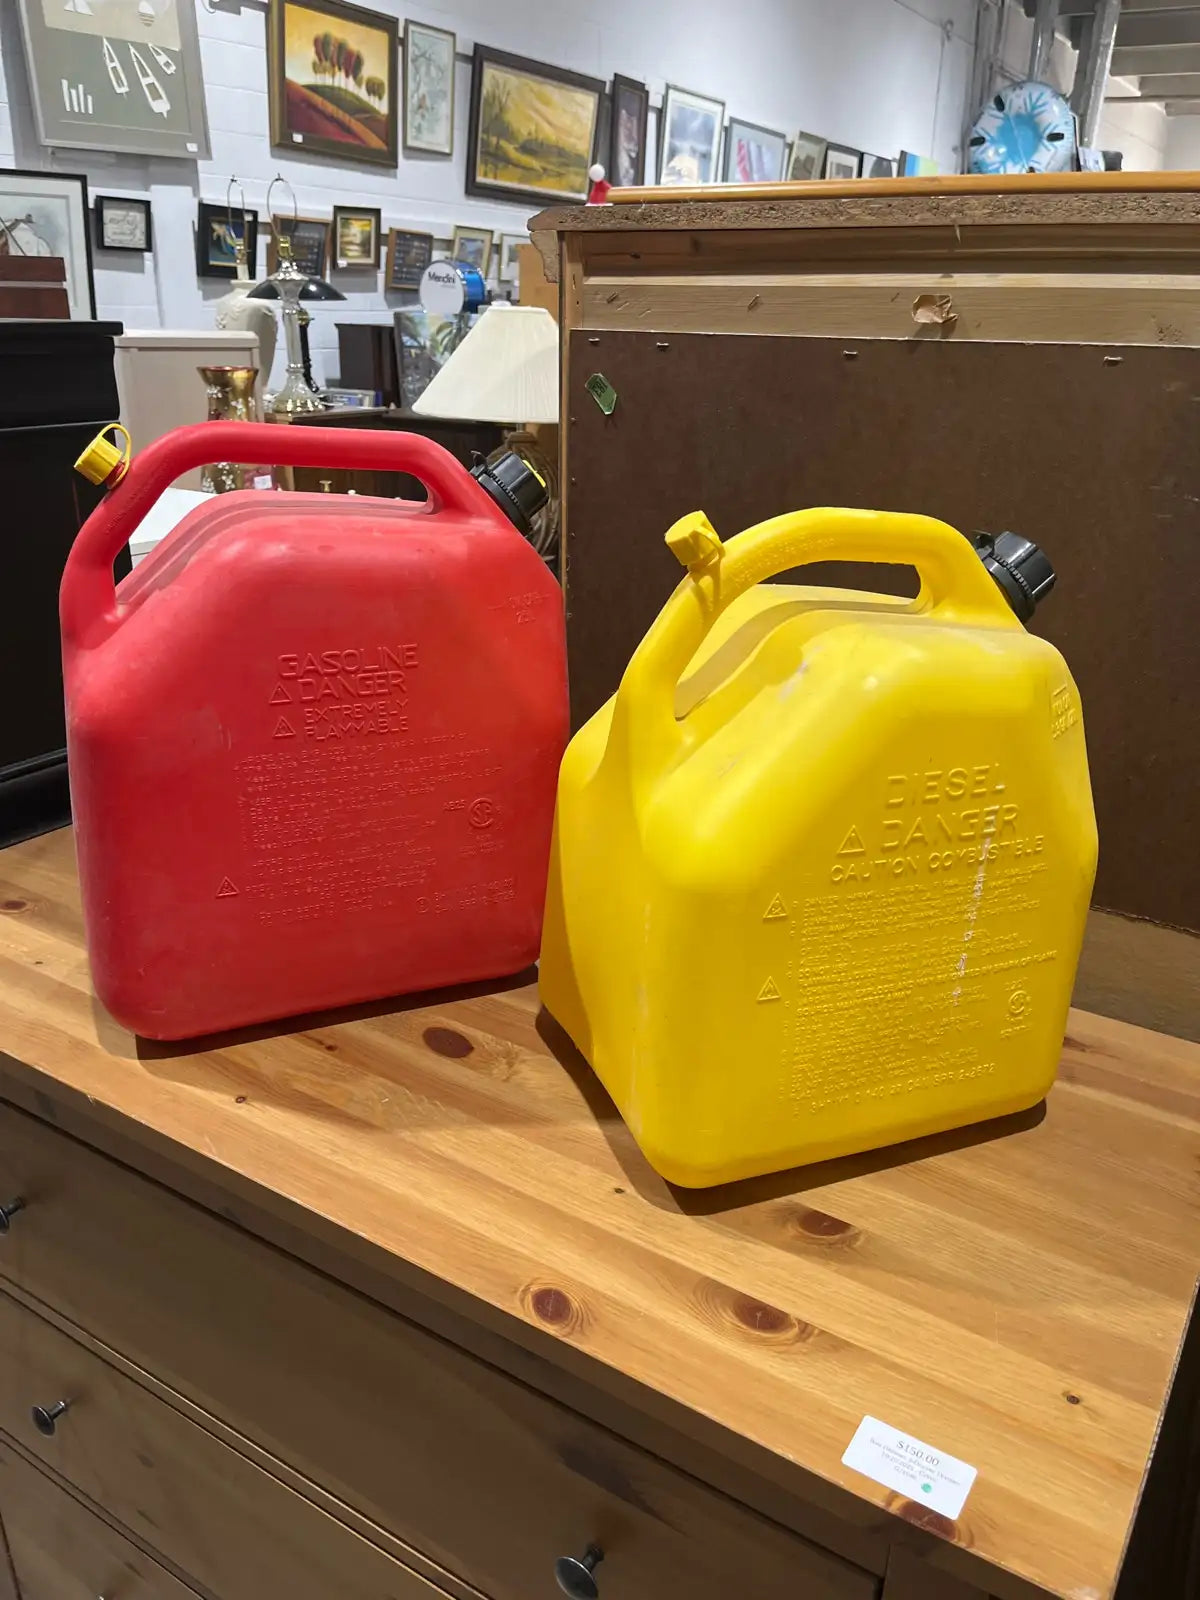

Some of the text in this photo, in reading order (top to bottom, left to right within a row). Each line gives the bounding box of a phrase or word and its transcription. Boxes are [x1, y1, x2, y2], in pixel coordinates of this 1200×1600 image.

[278, 643, 419, 677] GASOLINE
[297, 670, 408, 702] DANGER
[303, 699, 409, 723] EXTREMELY
[303, 716, 409, 741] FLAMMABLE
[886, 762, 1006, 806] DIESEL
[880, 803, 1018, 852] DANGER
[831, 855, 920, 883] CAUTION
[928, 835, 1045, 869] COMBUSTIBLE
[896, 1440, 940, 1466] $150.00
